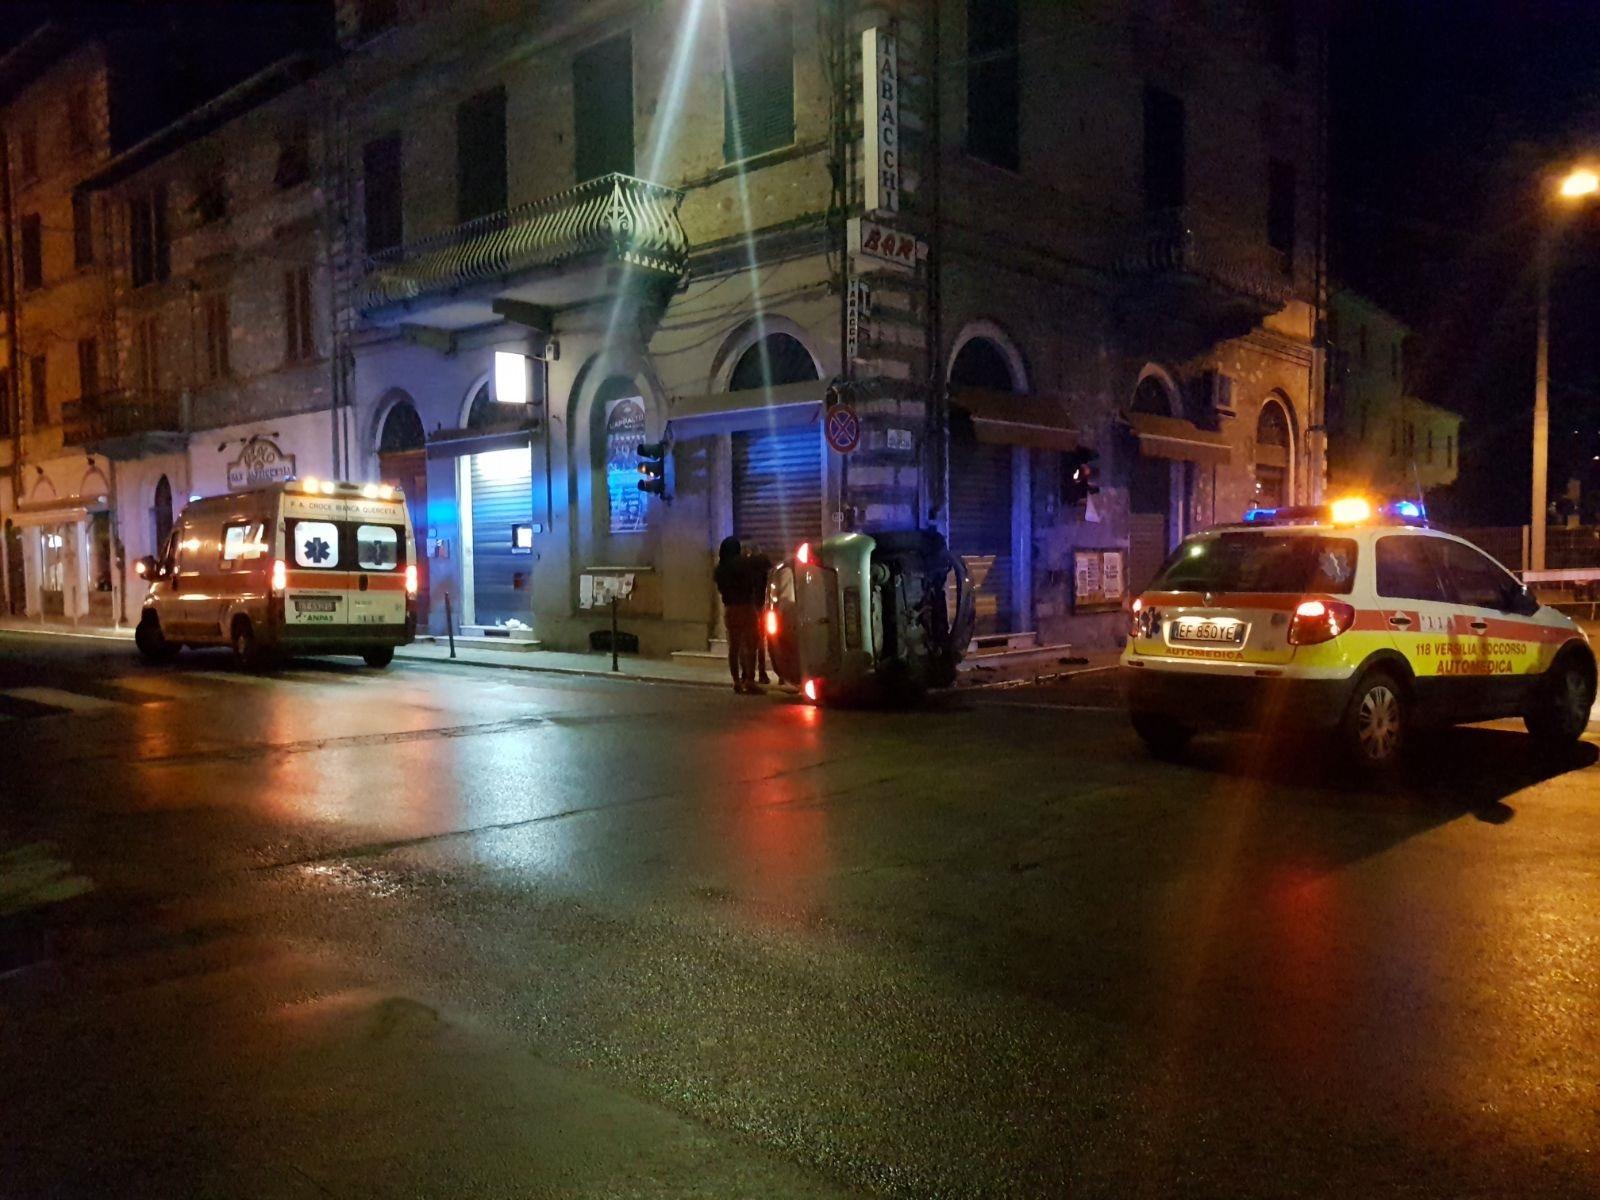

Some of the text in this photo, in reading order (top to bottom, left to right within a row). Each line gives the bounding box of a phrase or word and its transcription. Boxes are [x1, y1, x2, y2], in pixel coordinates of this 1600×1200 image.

[880, 34, 896, 212] TABACCHI
[863, 226, 915, 261] BAR
[848, 281, 858, 354] TABACCHI
[1165, 648, 1244, 660] AUTOMEDICA
[1416, 643, 1527, 656] 118 VERSILIA SOCCORSO
[1436, 660, 1513, 674] AUTOMEDICA
